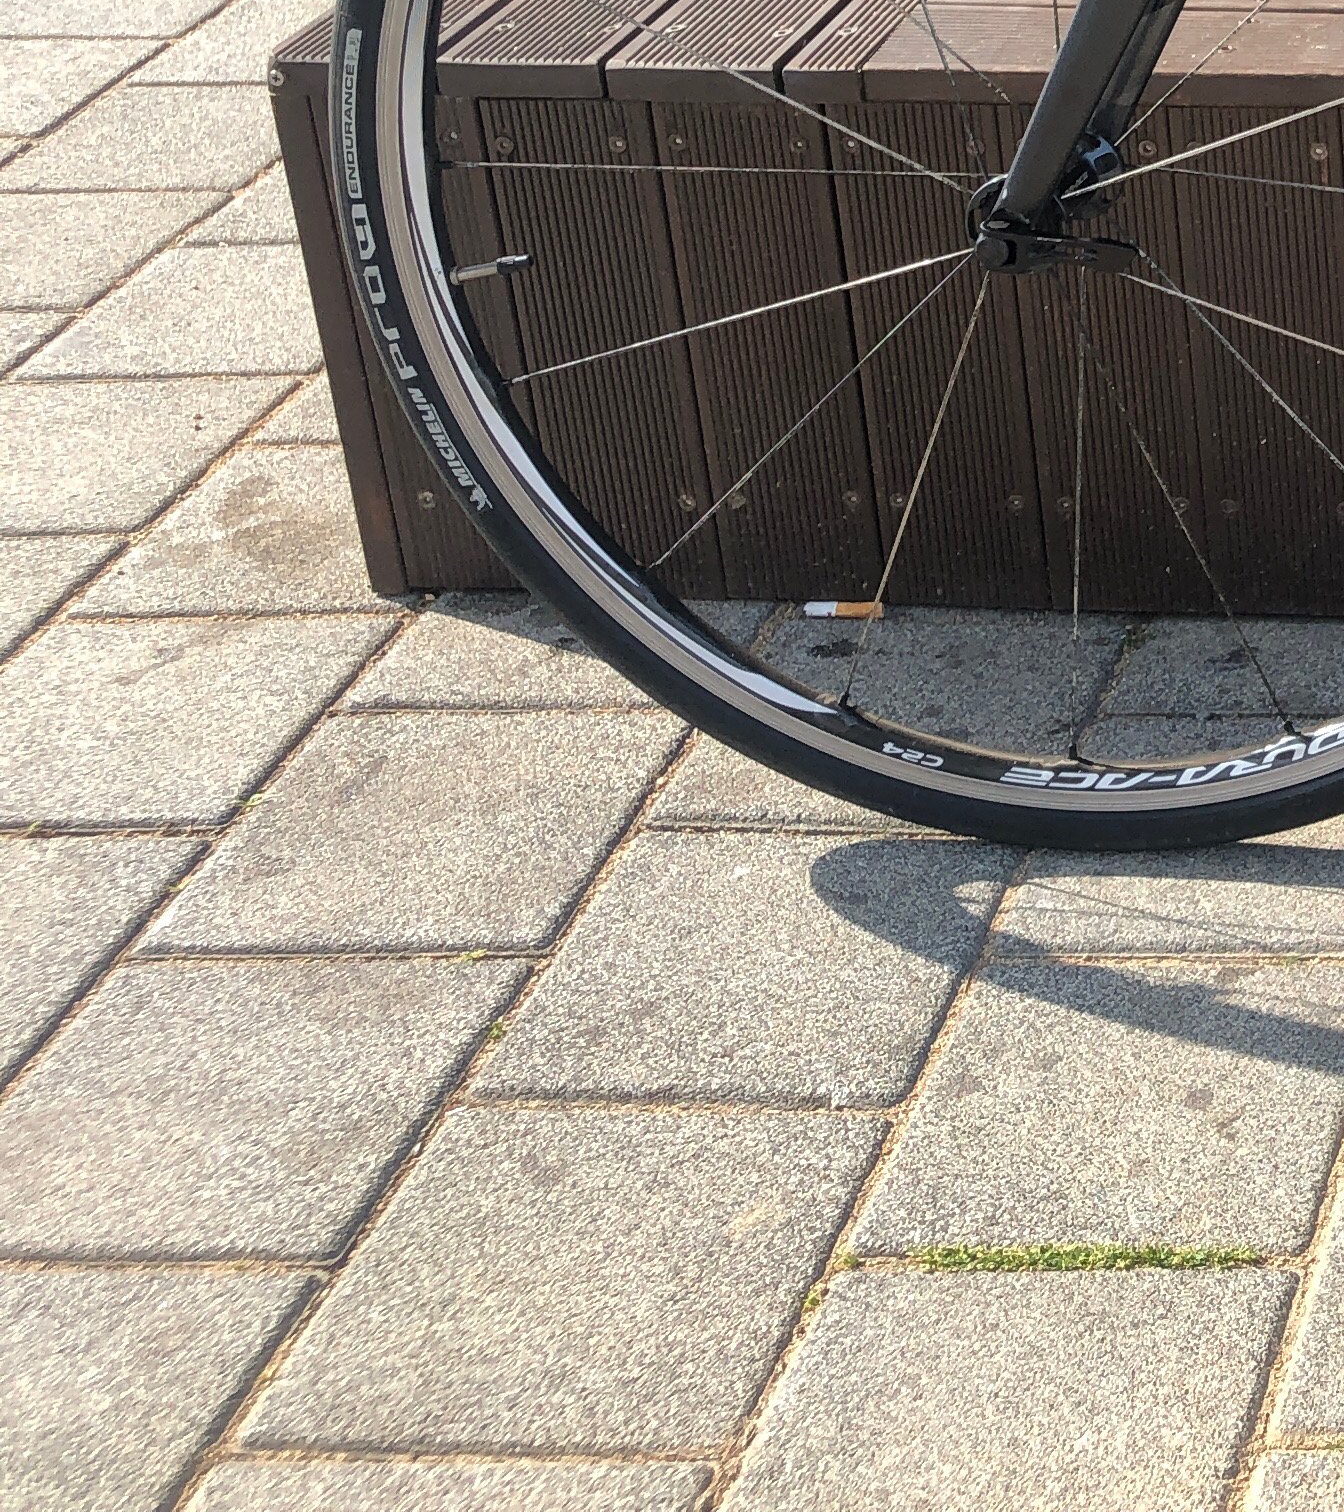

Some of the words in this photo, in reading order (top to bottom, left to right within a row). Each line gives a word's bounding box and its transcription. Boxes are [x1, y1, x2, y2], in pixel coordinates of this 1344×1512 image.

[343, 63, 360, 195] ENDURANCE
[406, 386, 475, 488] MICHELIN
[880, 740, 946, 769] C24
